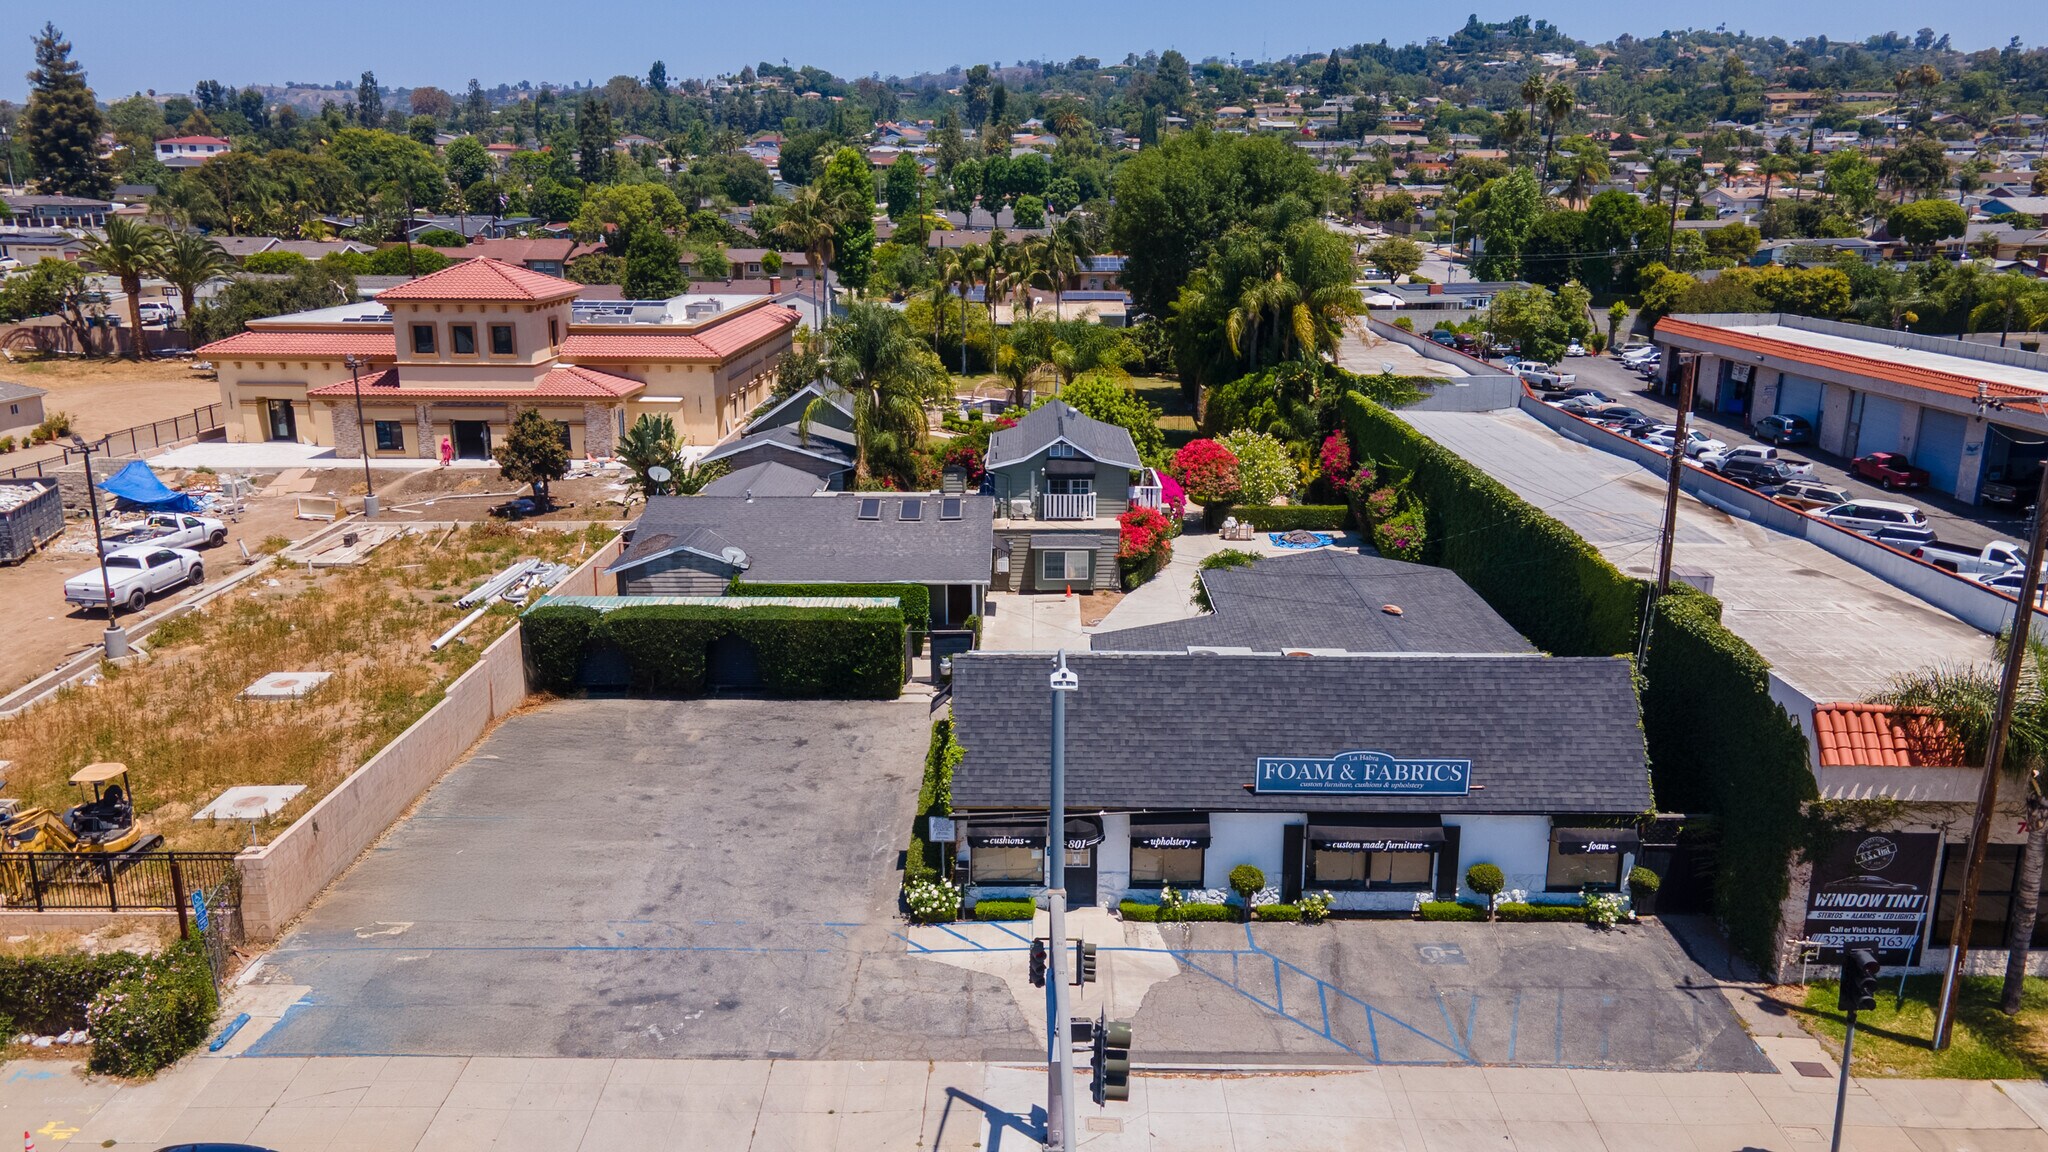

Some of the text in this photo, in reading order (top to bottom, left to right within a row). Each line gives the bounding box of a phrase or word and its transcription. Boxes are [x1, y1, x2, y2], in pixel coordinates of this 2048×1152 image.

[1264, 762, 1462, 781] FOAM & FABRICS
[990, 835, 1024, 844] cushions
[1068, 839, 1086, 849] 801
[1150, 836, 1191, 848] upholstery
[1332, 840, 1423, 851] custom made furniture
[1586, 841, 1609, 852] foam
[1815, 893, 1923, 908] WINDOW TINT
